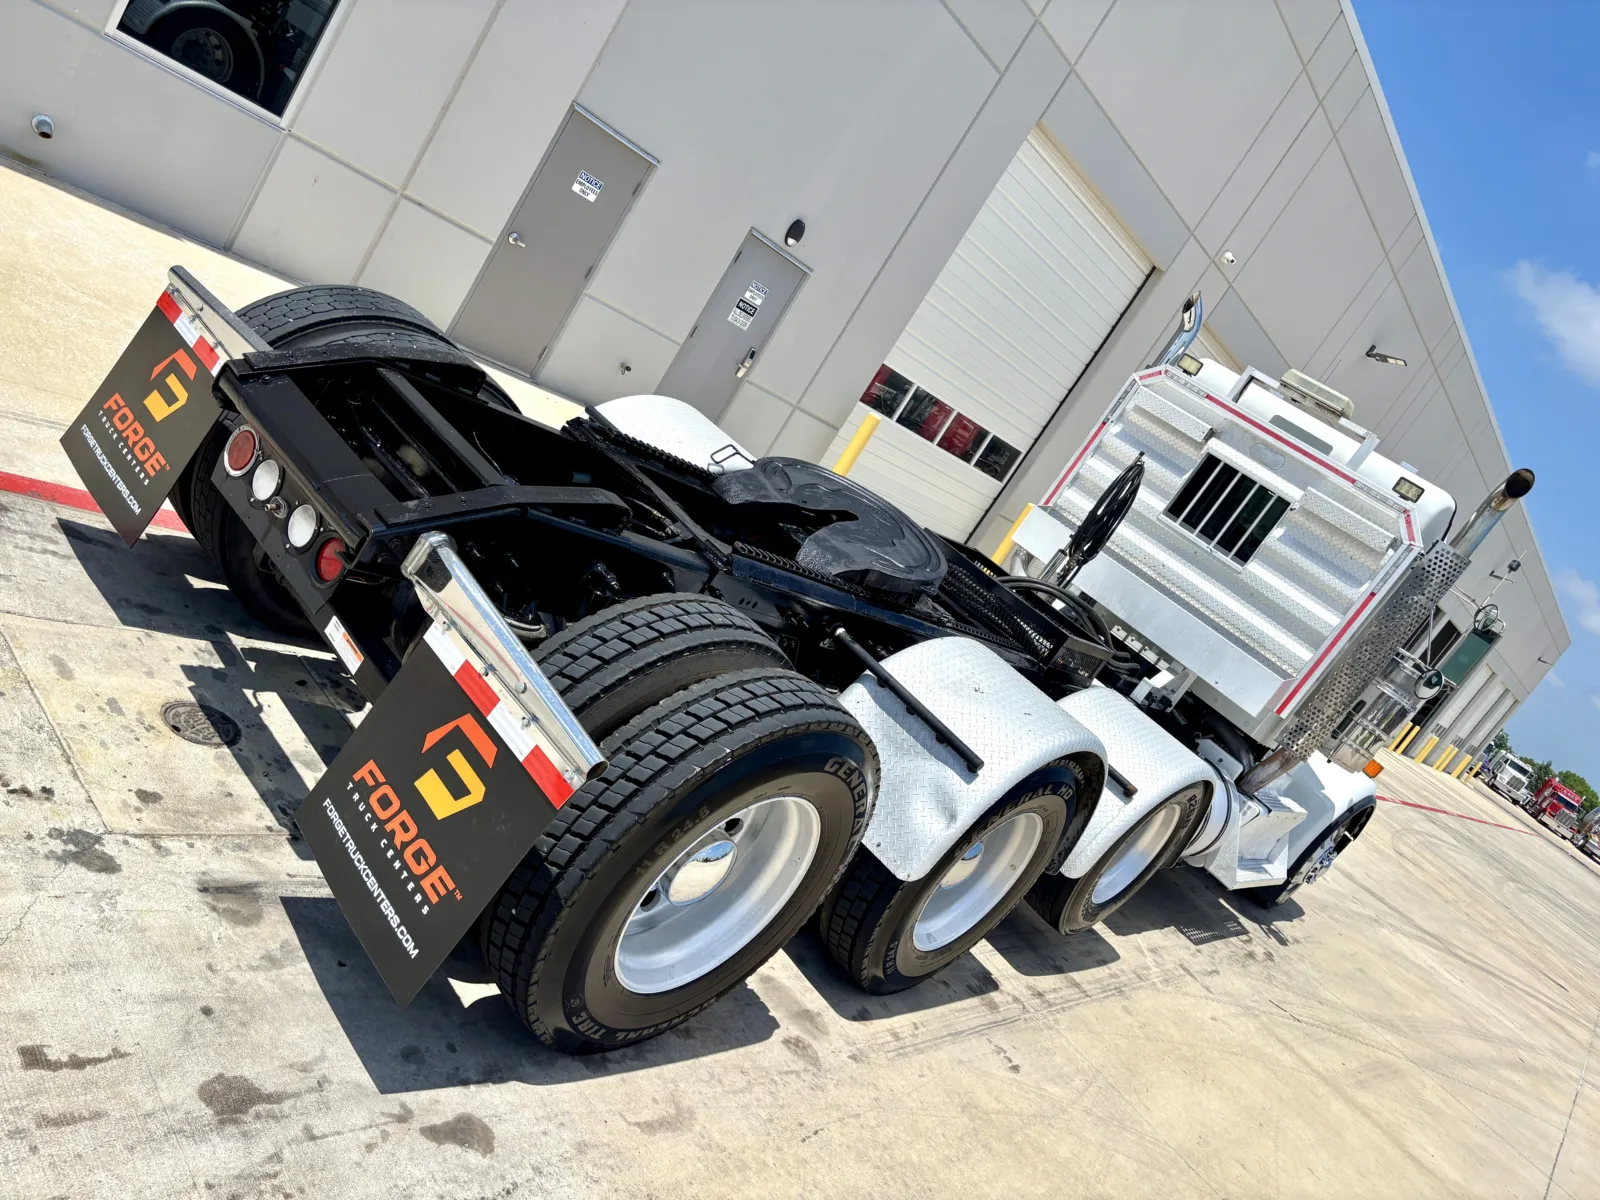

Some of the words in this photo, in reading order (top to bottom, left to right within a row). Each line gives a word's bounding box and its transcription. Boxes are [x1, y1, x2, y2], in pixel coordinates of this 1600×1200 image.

[576, 179, 599, 196] EMPLOYEES
[579, 188, 590, 197] ONLY
[580, 172, 602, 190] NOTICE
[738, 301, 756, 315] NOTICE
[98, 410, 117, 441] TRUCK
[118, 442, 149, 486] CENTERS
[102, 392, 167, 478] FORGE
[80, 423, 142, 515] FORGETRUCKCENTERS.COM
[1057, 784, 1074, 800] HD
[346, 781, 378, 833] TRUCK
[380, 838, 429, 915] CENTERS
[352, 759, 456, 904] FORGE
[322, 798, 420, 959] FORGETRUCKCENTERS.COM
[571, 1011, 607, 1040] TIRE
